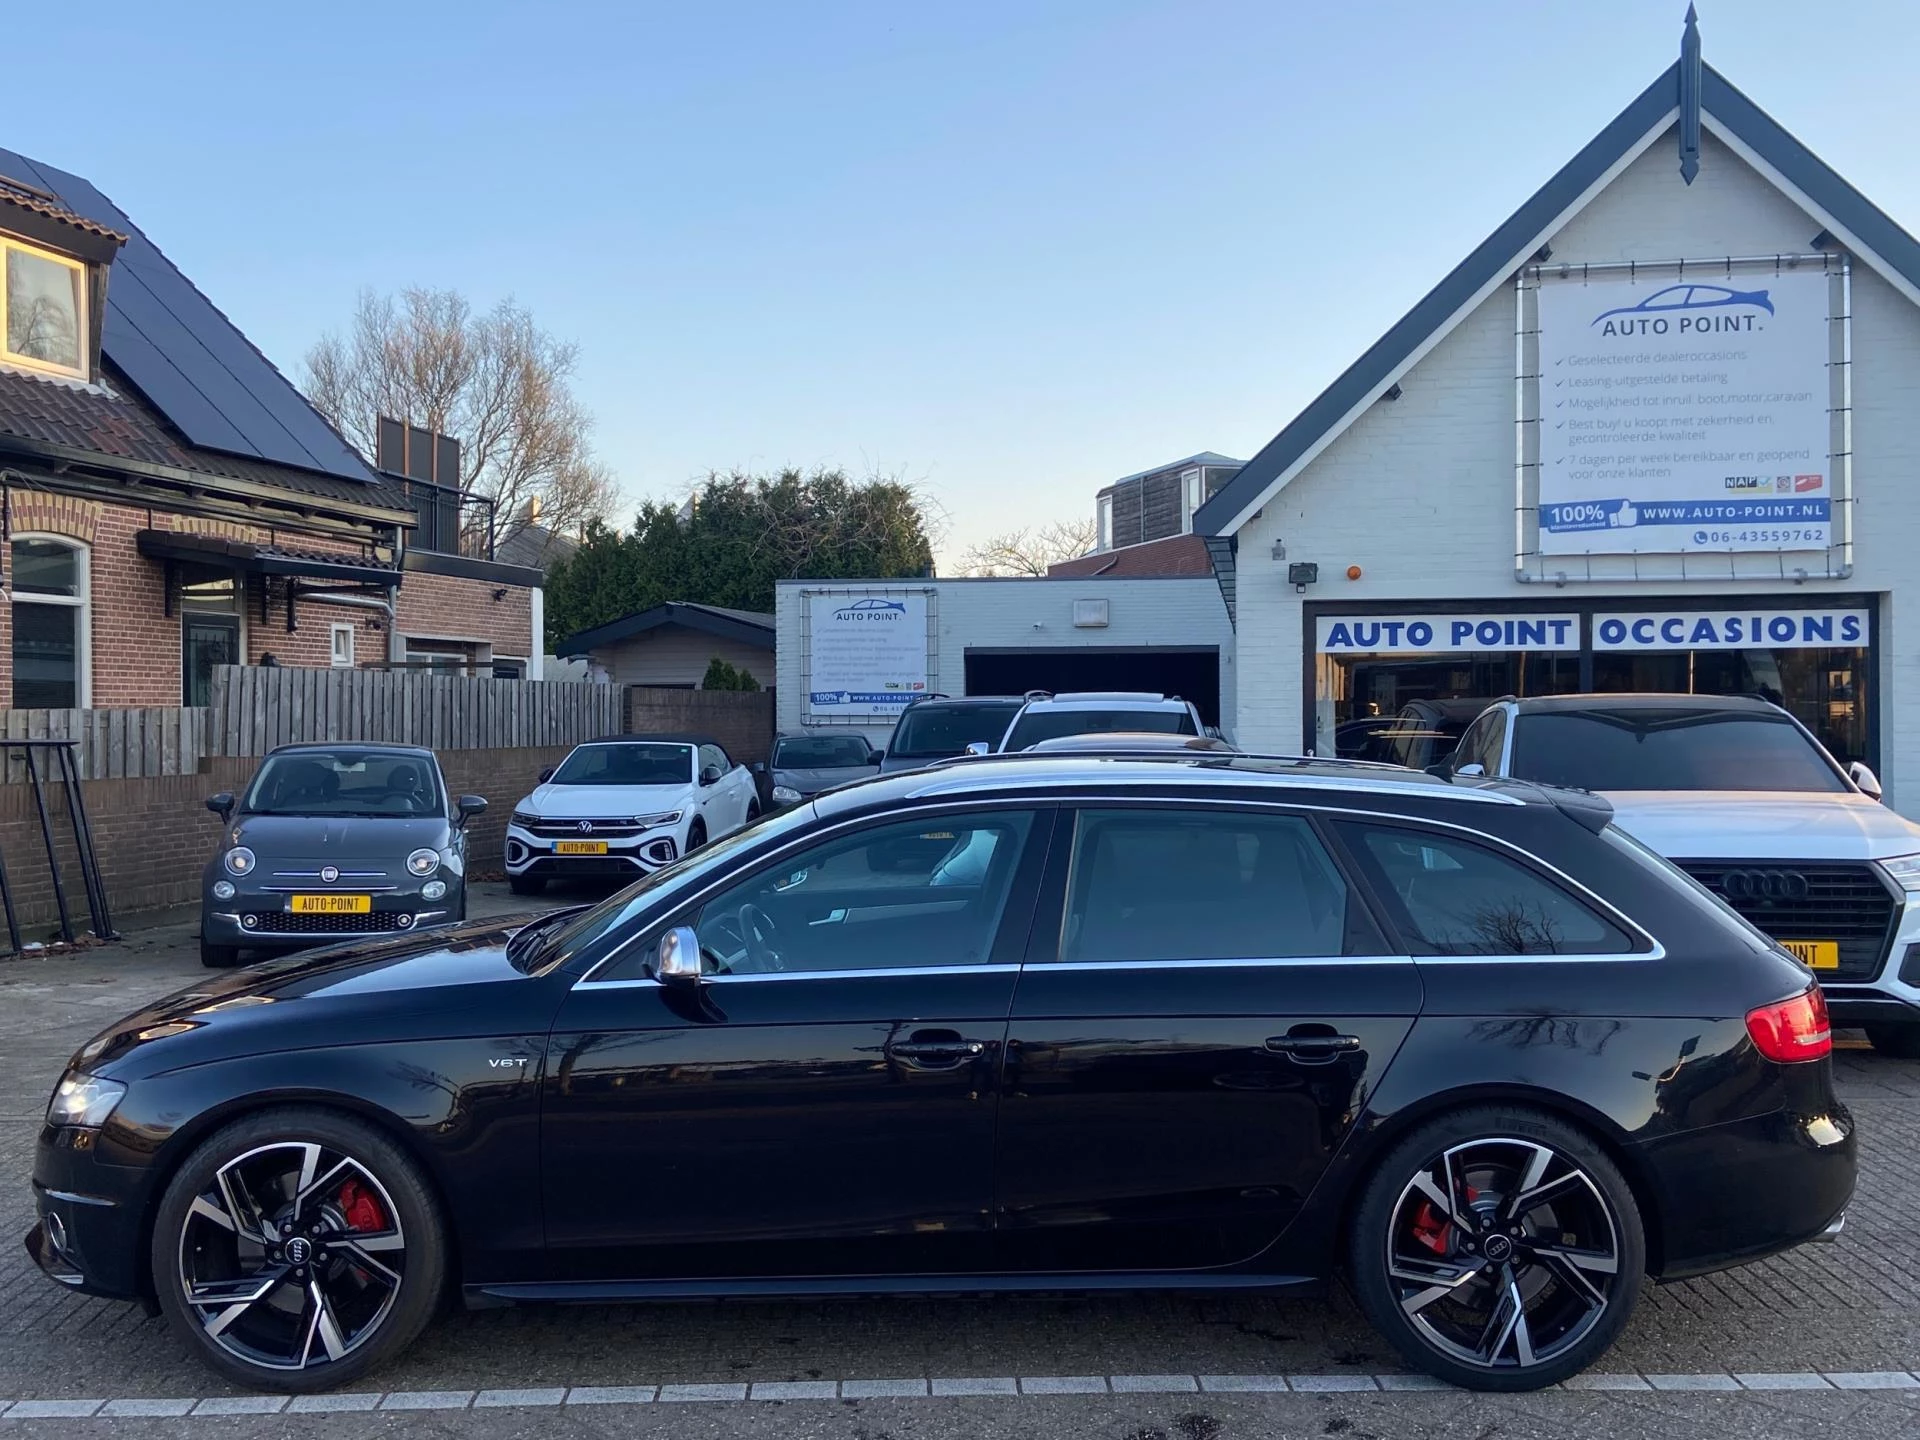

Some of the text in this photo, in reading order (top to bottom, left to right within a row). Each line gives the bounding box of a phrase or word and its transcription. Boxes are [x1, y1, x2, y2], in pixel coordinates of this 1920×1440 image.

[1602, 318, 1669, 337] AUTO
[1568, 349, 1747, 366] Geselecteerde dealeroccasions
[1681, 372, 1728, 385] betaling
[1568, 396, 1640, 411] Mogelijkheid
[1643, 396, 1659, 407] tot
[1568, 419, 1593, 430] Best
[1624, 420, 1632, 429] u
[1635, 416, 1668, 430] koopt
[1671, 417, 1693, 428] met
[1697, 414, 1754, 427] zekerheid
[1568, 429, 1706, 447] gecontroleerde kwaliteit
[1569, 455, 1577, 465] 7
[1579, 453, 1615, 468] dagen
[1618, 454, 1637, 467] per
[1673, 448, 1736, 463] bereikbaar
[1738, 451, 1754, 462] en
[1757, 448, 1810, 463] geopend
[1568, 466, 1671, 480] voor onze klanten
[1551, 504, 1823, 523] 100% WWW.AUTO-POINT.NL
[1711, 529, 1824, 543] 06-43559762
[836, 612, 864, 621] AUTO
[1326, 615, 1861, 648] AUTO POINT OCCASIONS
[562, 843, 600, 853] AUTO-POINT
[302, 897, 360, 911] AUTO-POINT
[488, 1058, 527, 1068] V6T
